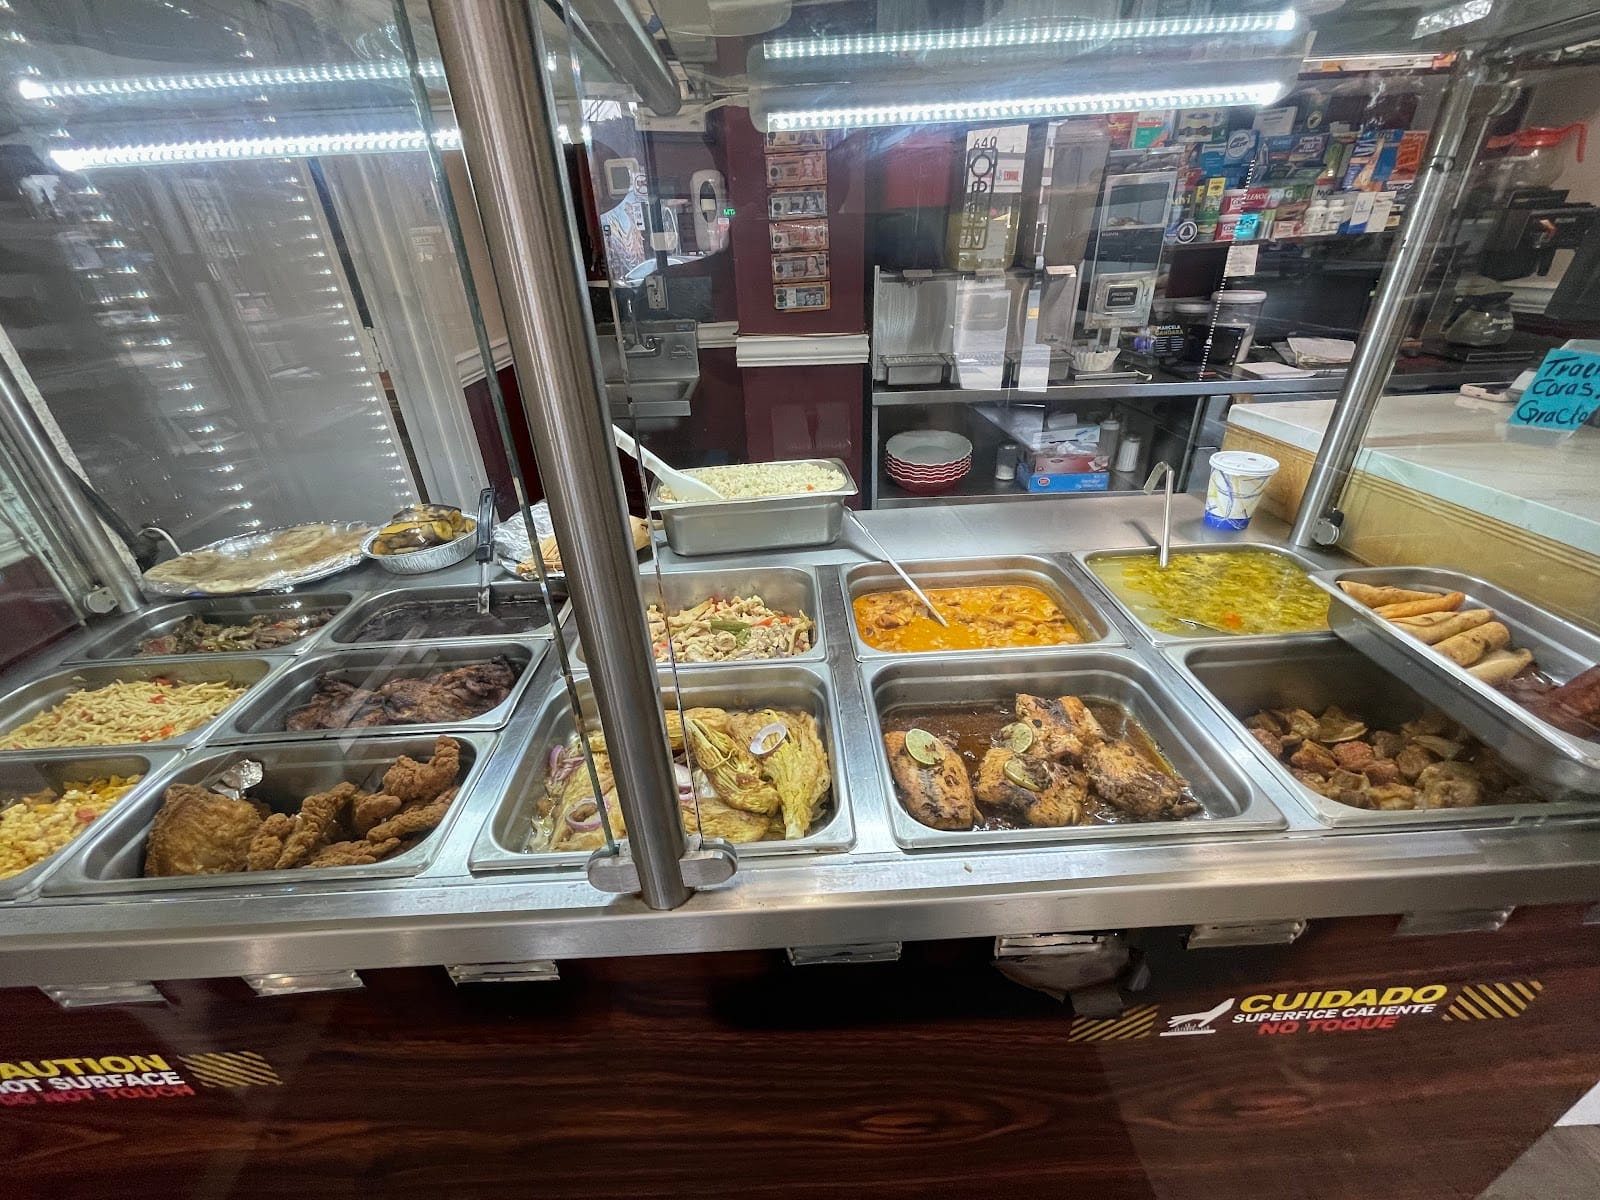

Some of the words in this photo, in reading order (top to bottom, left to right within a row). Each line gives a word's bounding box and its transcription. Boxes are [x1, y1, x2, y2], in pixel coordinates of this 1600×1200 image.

[1240, 984, 1448, 1013] CUIDADO
[1232, 1008, 1339, 1024] SUPERFICE
[1342, 1003, 1437, 1018] CALIENTE
[1258, 1021, 1300, 1035] NO
[1307, 1015, 1400, 1033] TOQUE
[0, 1054, 172, 1079] AUTION
[48, 1071, 185, 1091] SURFACE
